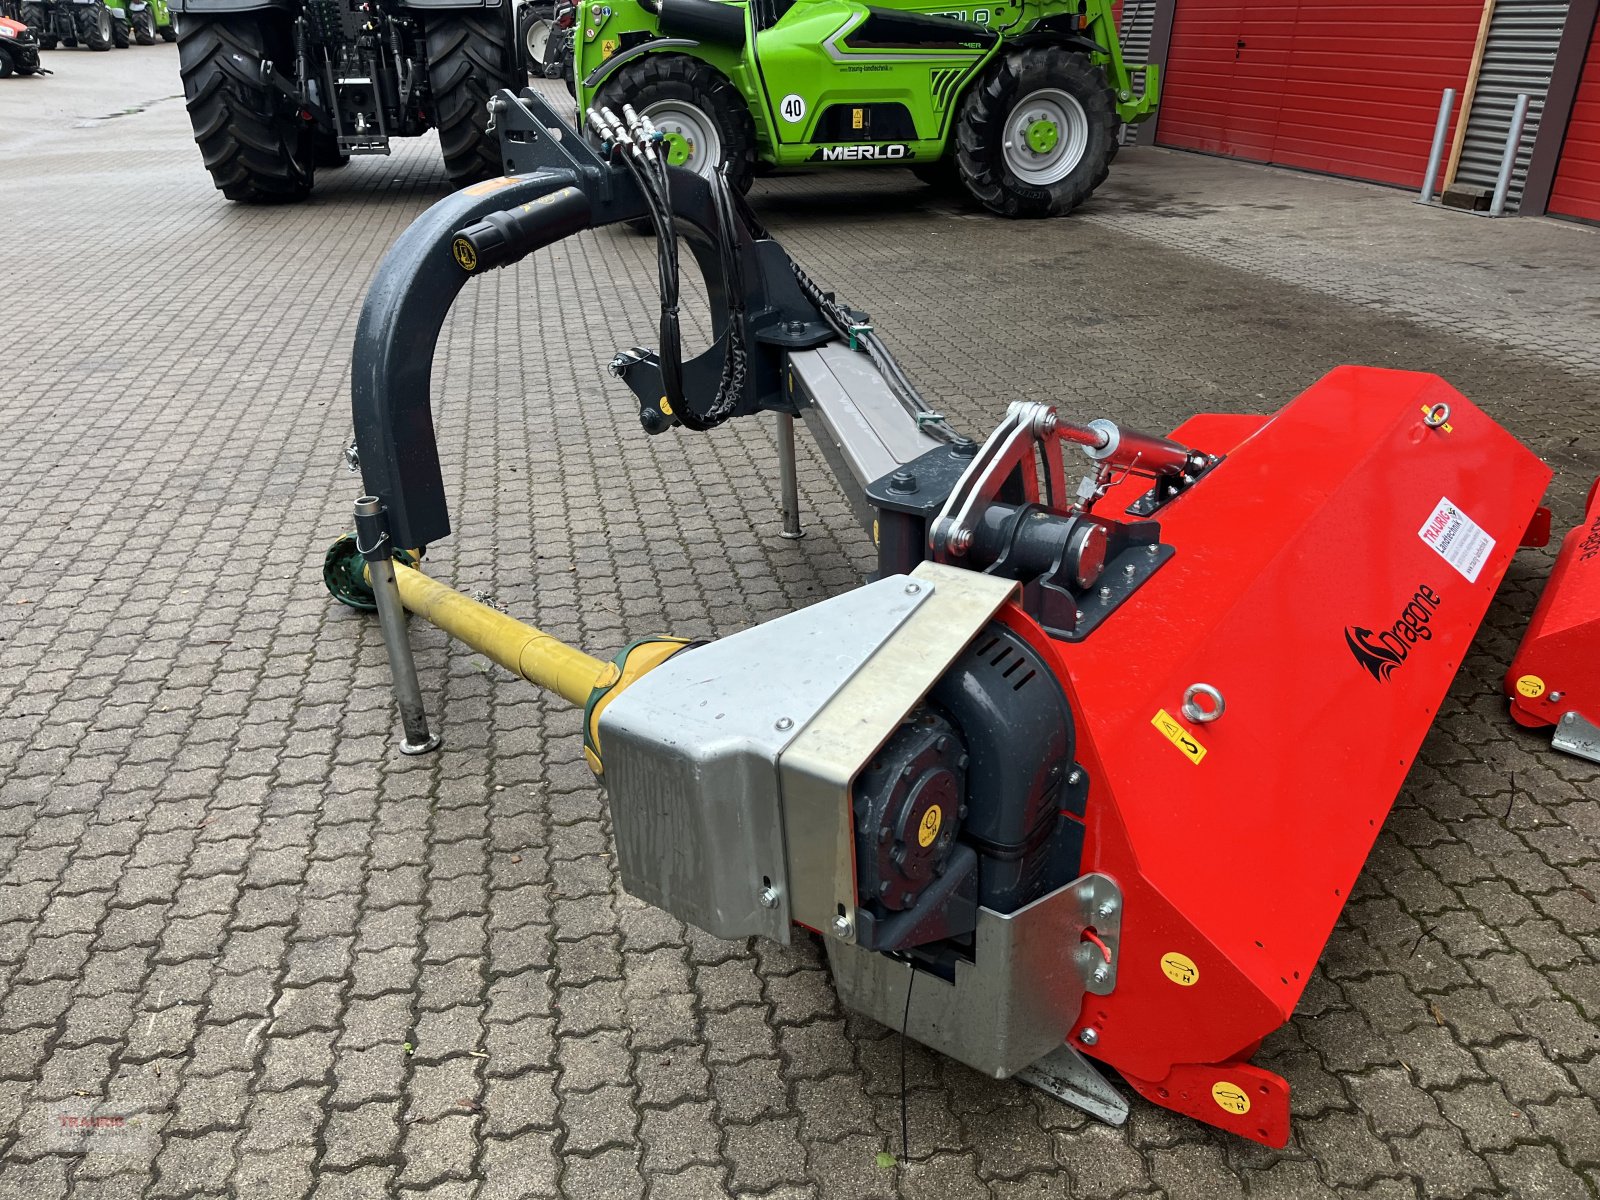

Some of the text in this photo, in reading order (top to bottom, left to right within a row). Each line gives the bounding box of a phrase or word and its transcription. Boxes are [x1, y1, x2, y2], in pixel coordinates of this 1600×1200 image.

[785, 99, 802, 117] 40
[822, 144, 905, 161] MERLO
[1423, 509, 1451, 544] TRAURIG
[1435, 518, 1462, 554] Landtechnik
[1378, 584, 1441, 662] Dragone
